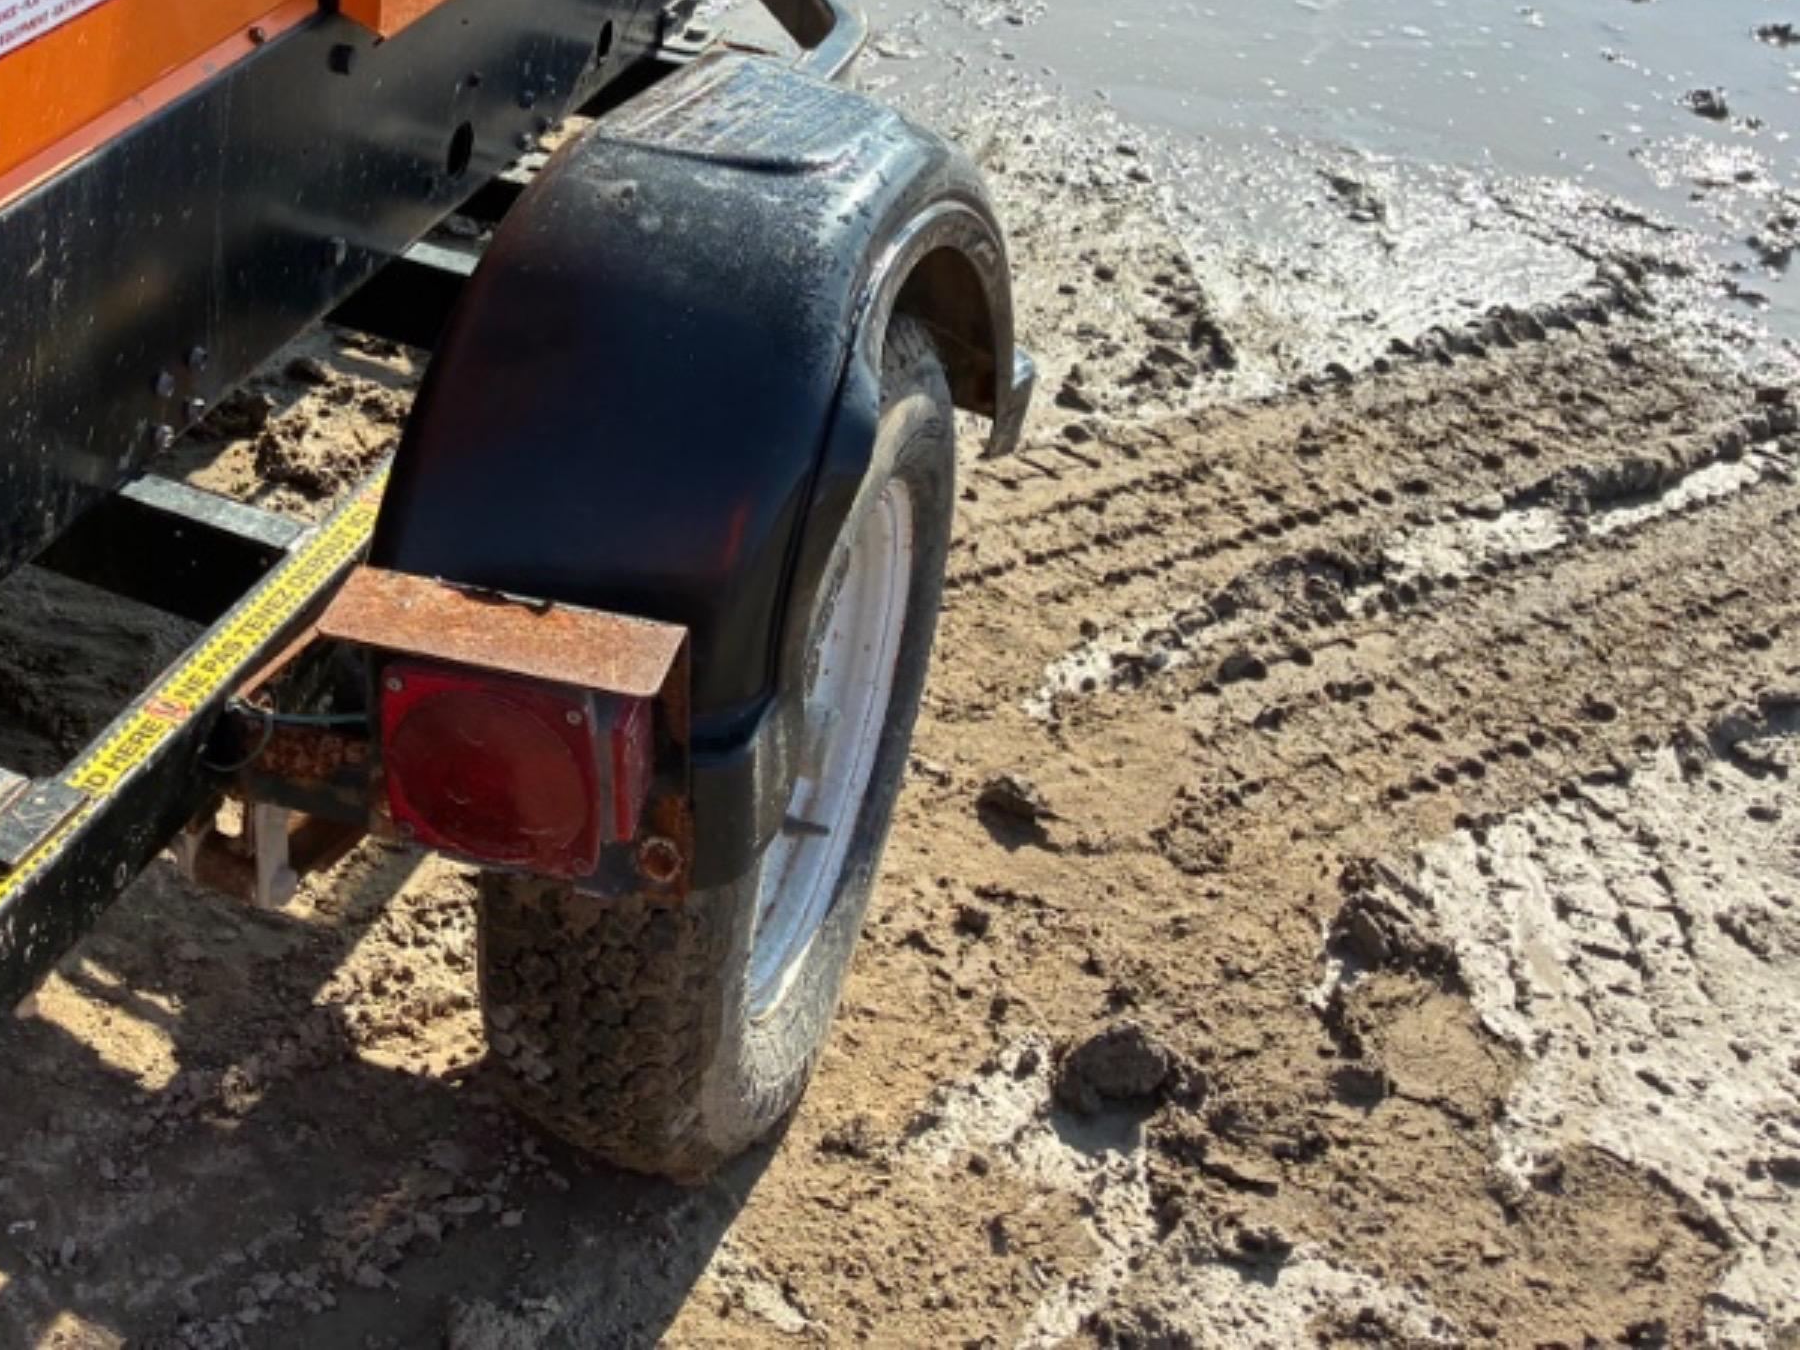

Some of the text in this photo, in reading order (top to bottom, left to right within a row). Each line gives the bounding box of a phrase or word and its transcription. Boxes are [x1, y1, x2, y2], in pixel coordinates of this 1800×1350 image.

[208, 638, 246, 675] PAS
[233, 589, 294, 641] TENEZ
[104, 718, 163, 776] HERE
